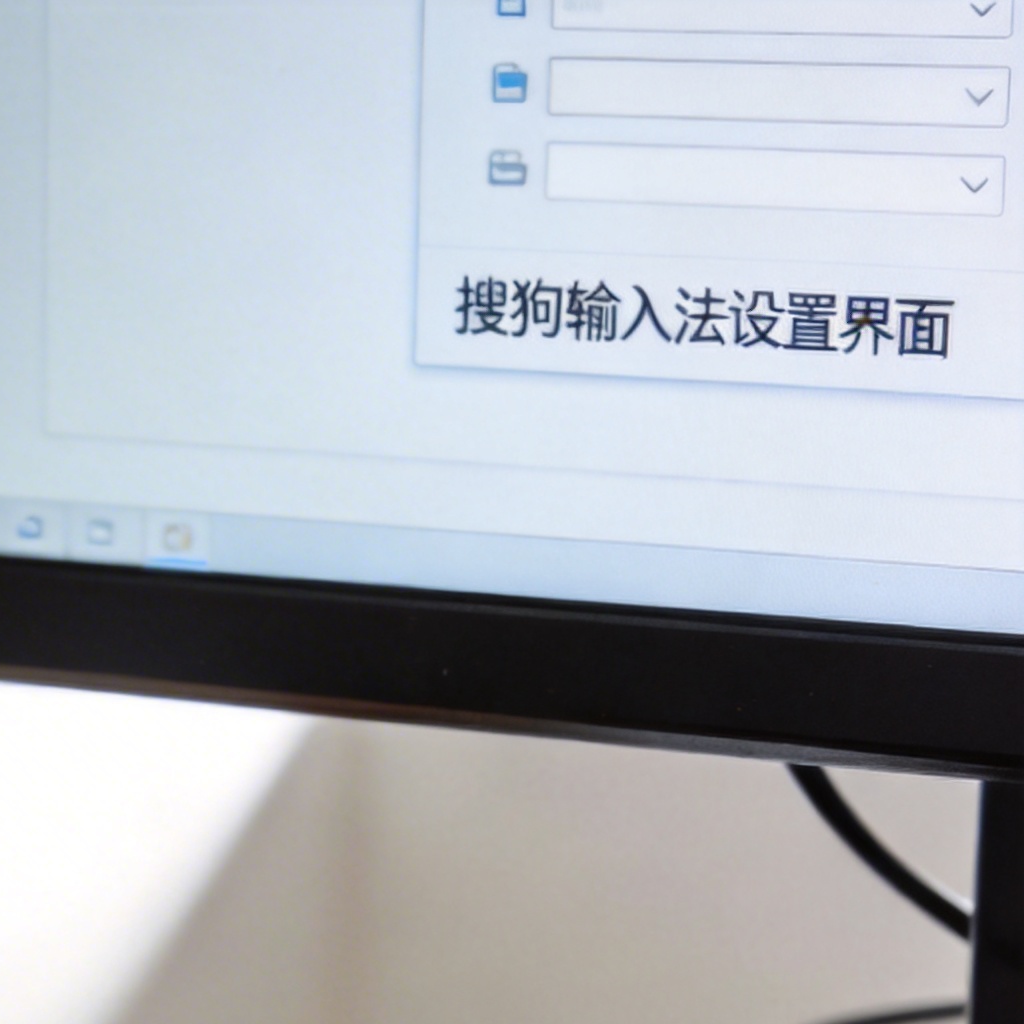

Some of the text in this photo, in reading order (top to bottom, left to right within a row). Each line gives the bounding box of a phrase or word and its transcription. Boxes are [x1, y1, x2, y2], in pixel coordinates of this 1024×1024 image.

[455, 275, 956, 361] 搜狗输入法设置界面
